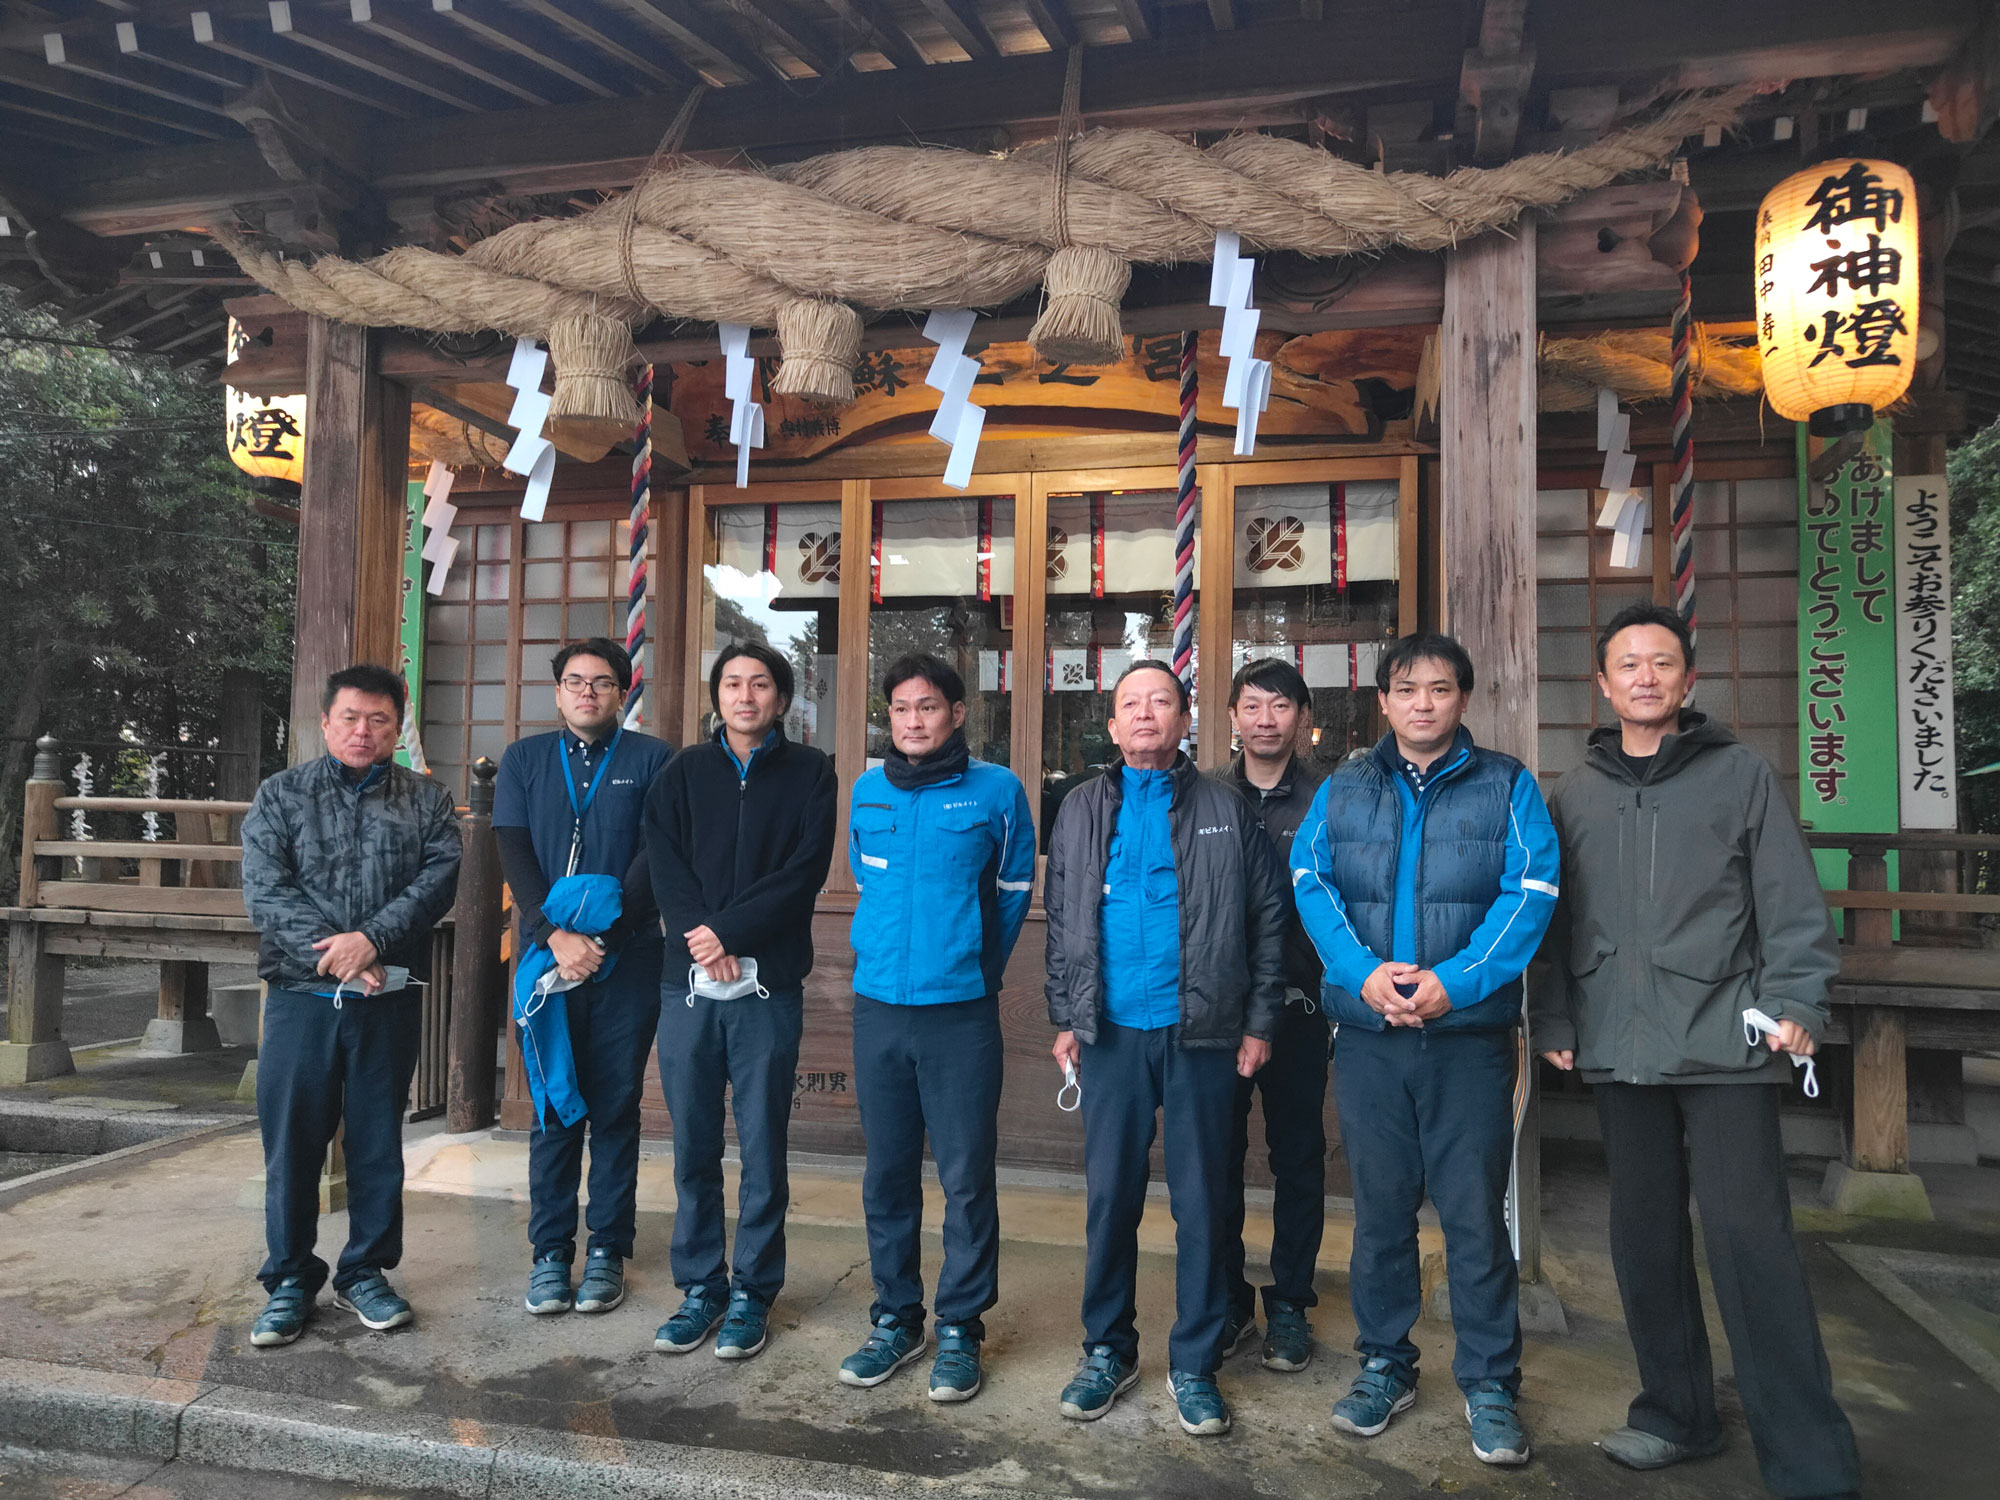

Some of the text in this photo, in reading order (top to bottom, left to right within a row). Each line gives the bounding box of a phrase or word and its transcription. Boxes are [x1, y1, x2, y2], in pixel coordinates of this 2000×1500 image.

[1802, 162, 1908, 368] 御神燈
[1849, 450, 1888, 625] あけまして
[1901, 488, 1950, 800] ようこそお参りくださいました。
